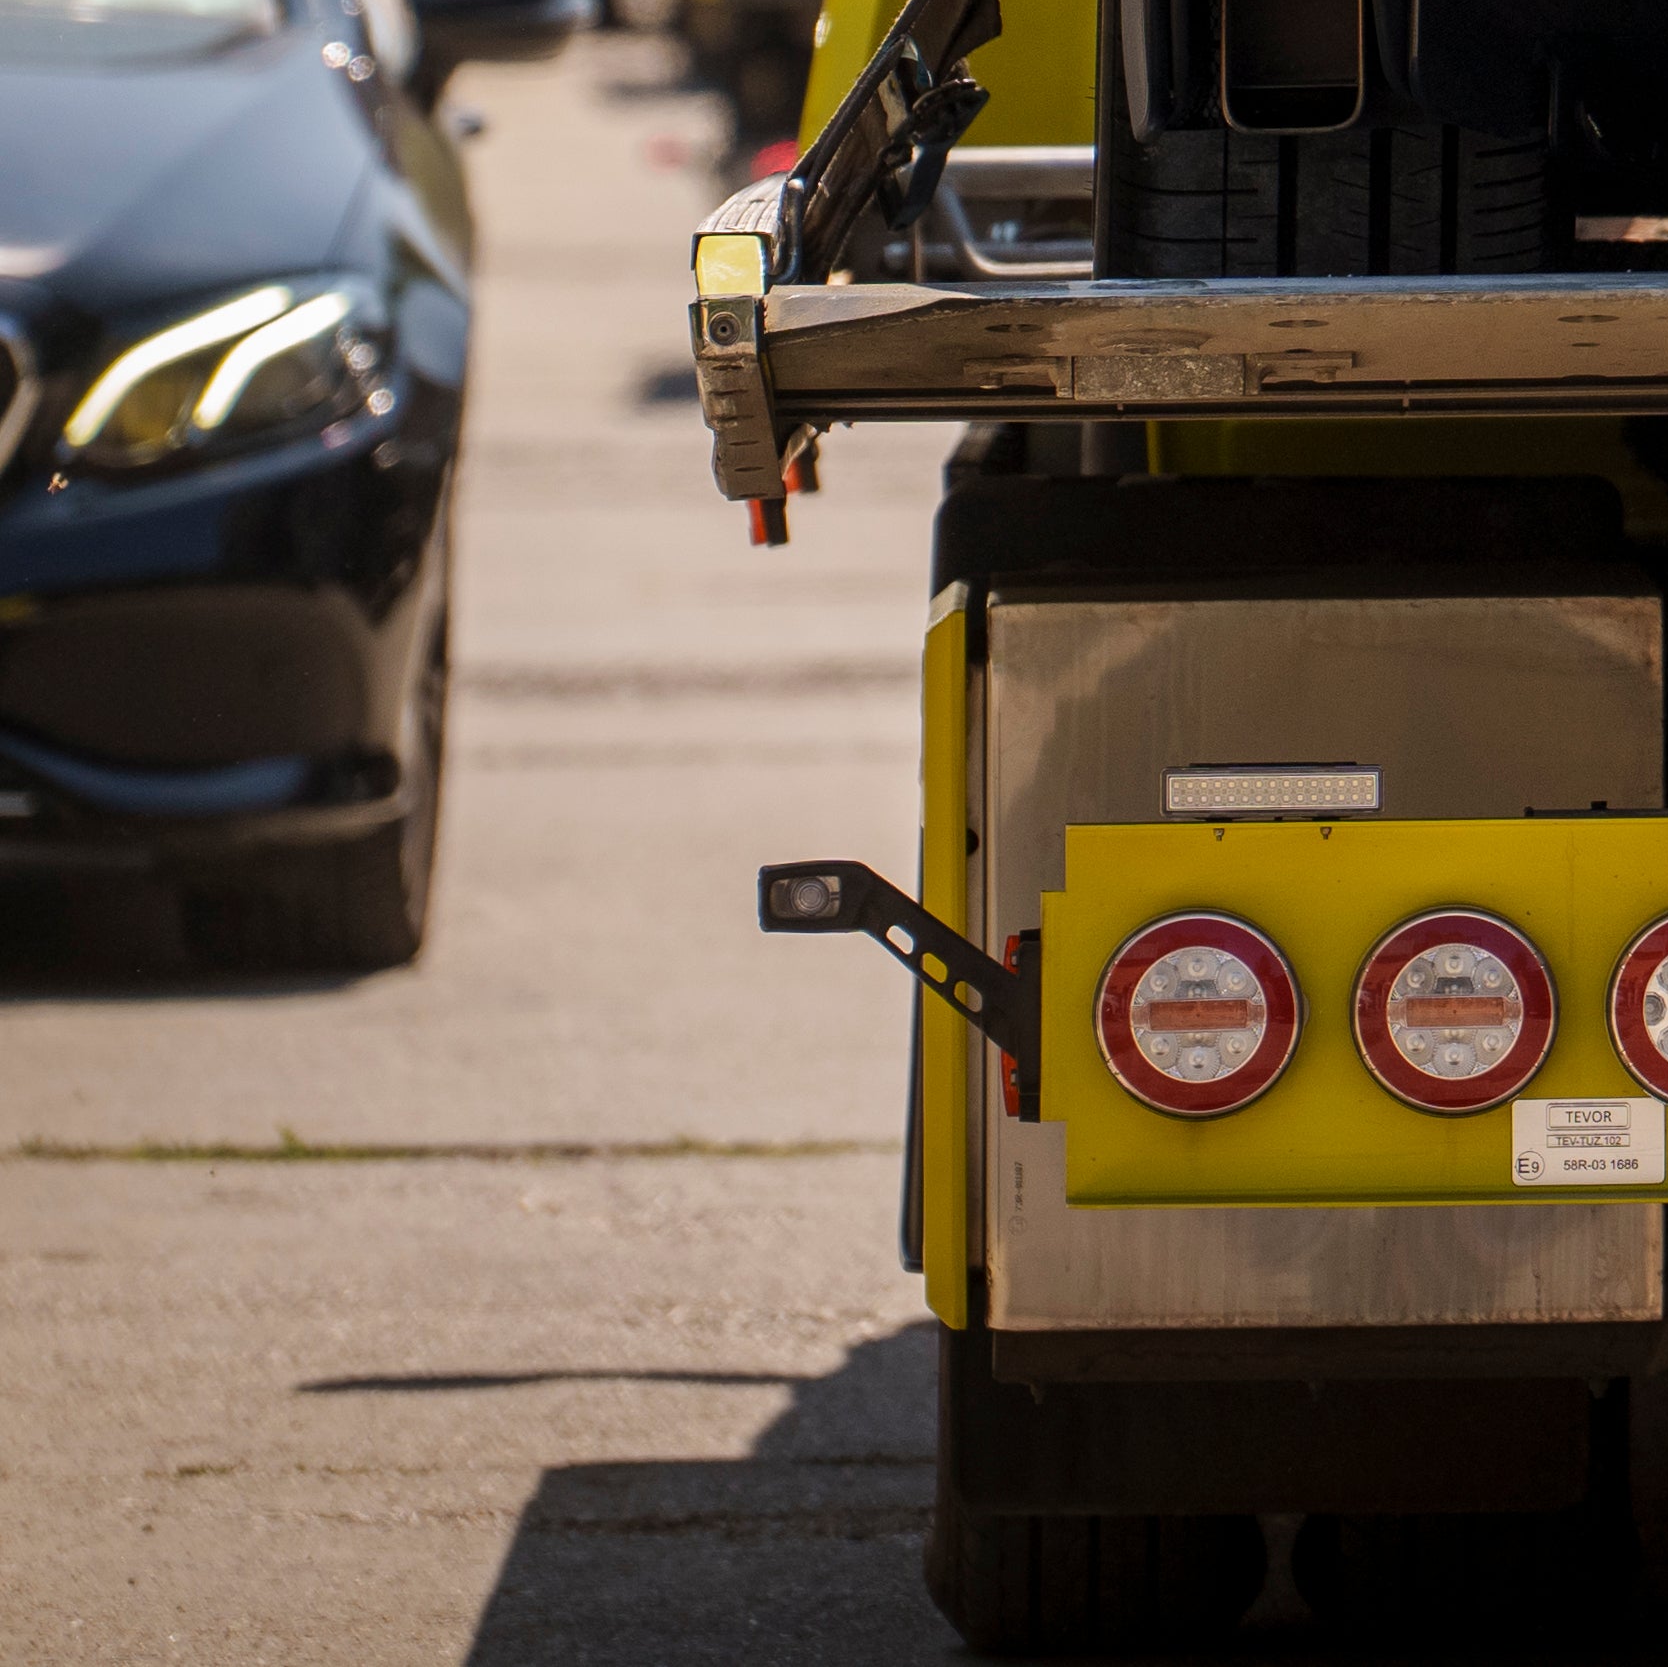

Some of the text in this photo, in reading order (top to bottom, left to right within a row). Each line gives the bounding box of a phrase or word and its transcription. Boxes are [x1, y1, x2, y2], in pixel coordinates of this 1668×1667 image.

[1565, 1110, 1612, 1124] TEVOR
[1563, 1158, 1639, 1171] 58R-03 1686
